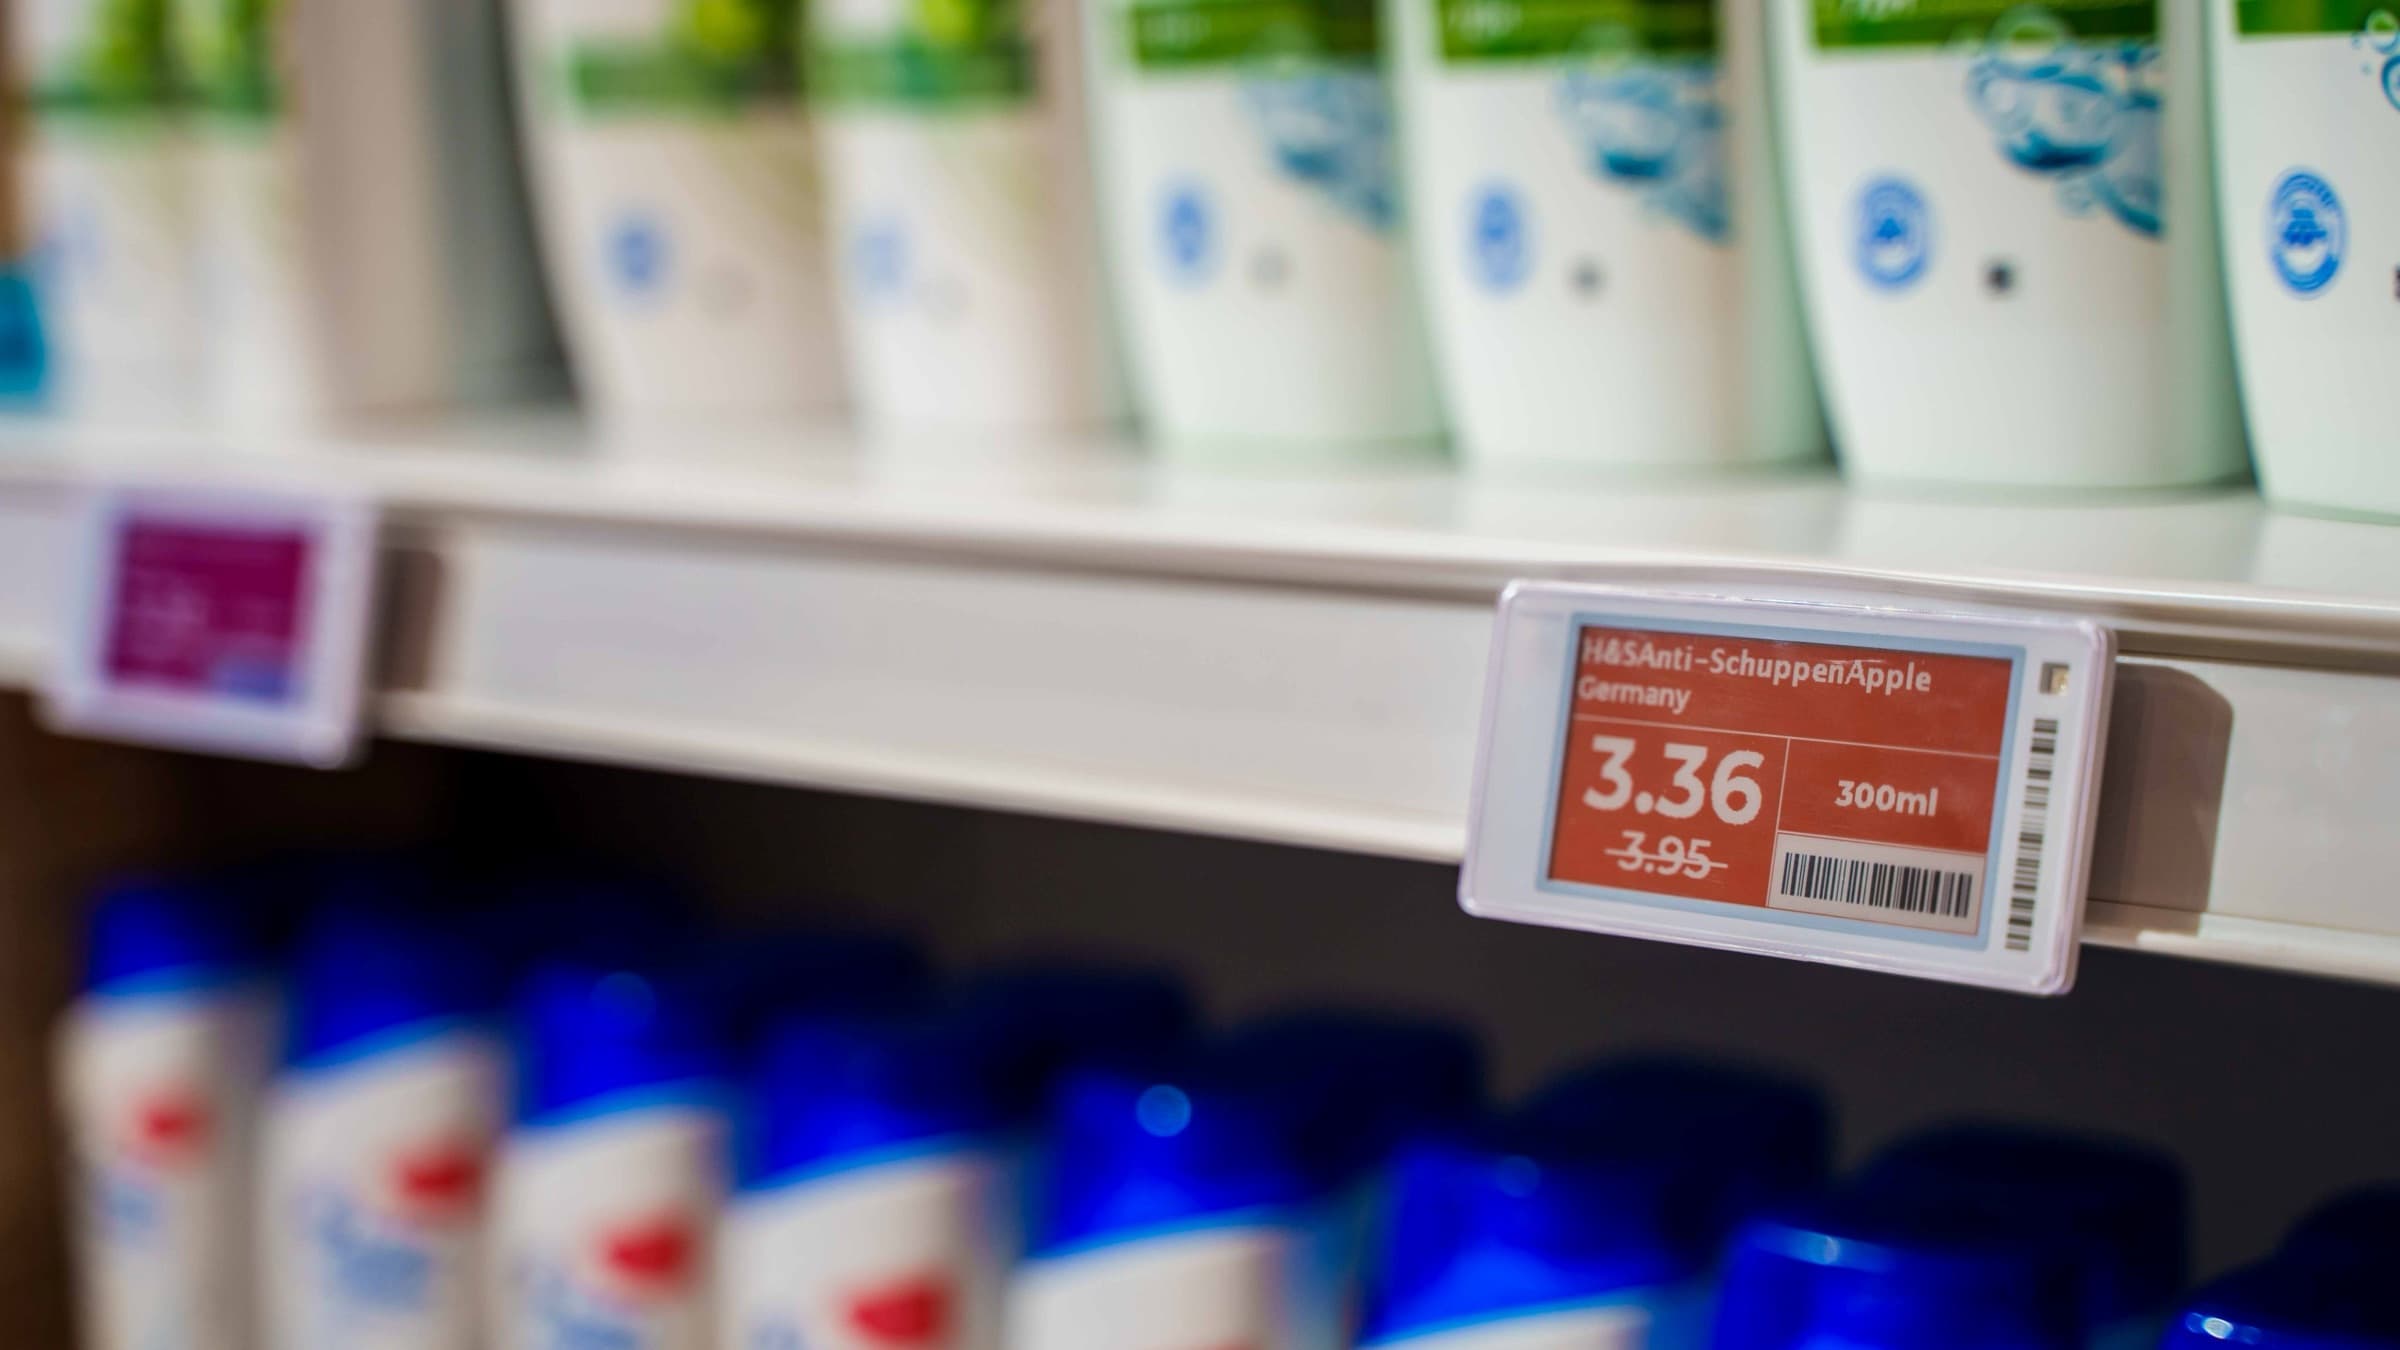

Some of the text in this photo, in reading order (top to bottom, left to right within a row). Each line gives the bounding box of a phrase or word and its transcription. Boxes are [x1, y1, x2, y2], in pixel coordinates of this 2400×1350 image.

[1577, 676, 1691, 713] Germany
[1583, 736, 1765, 825] 3.36
[1836, 780, 1938, 817] 300ml
[1613, 830, 1714, 880] 3.95
